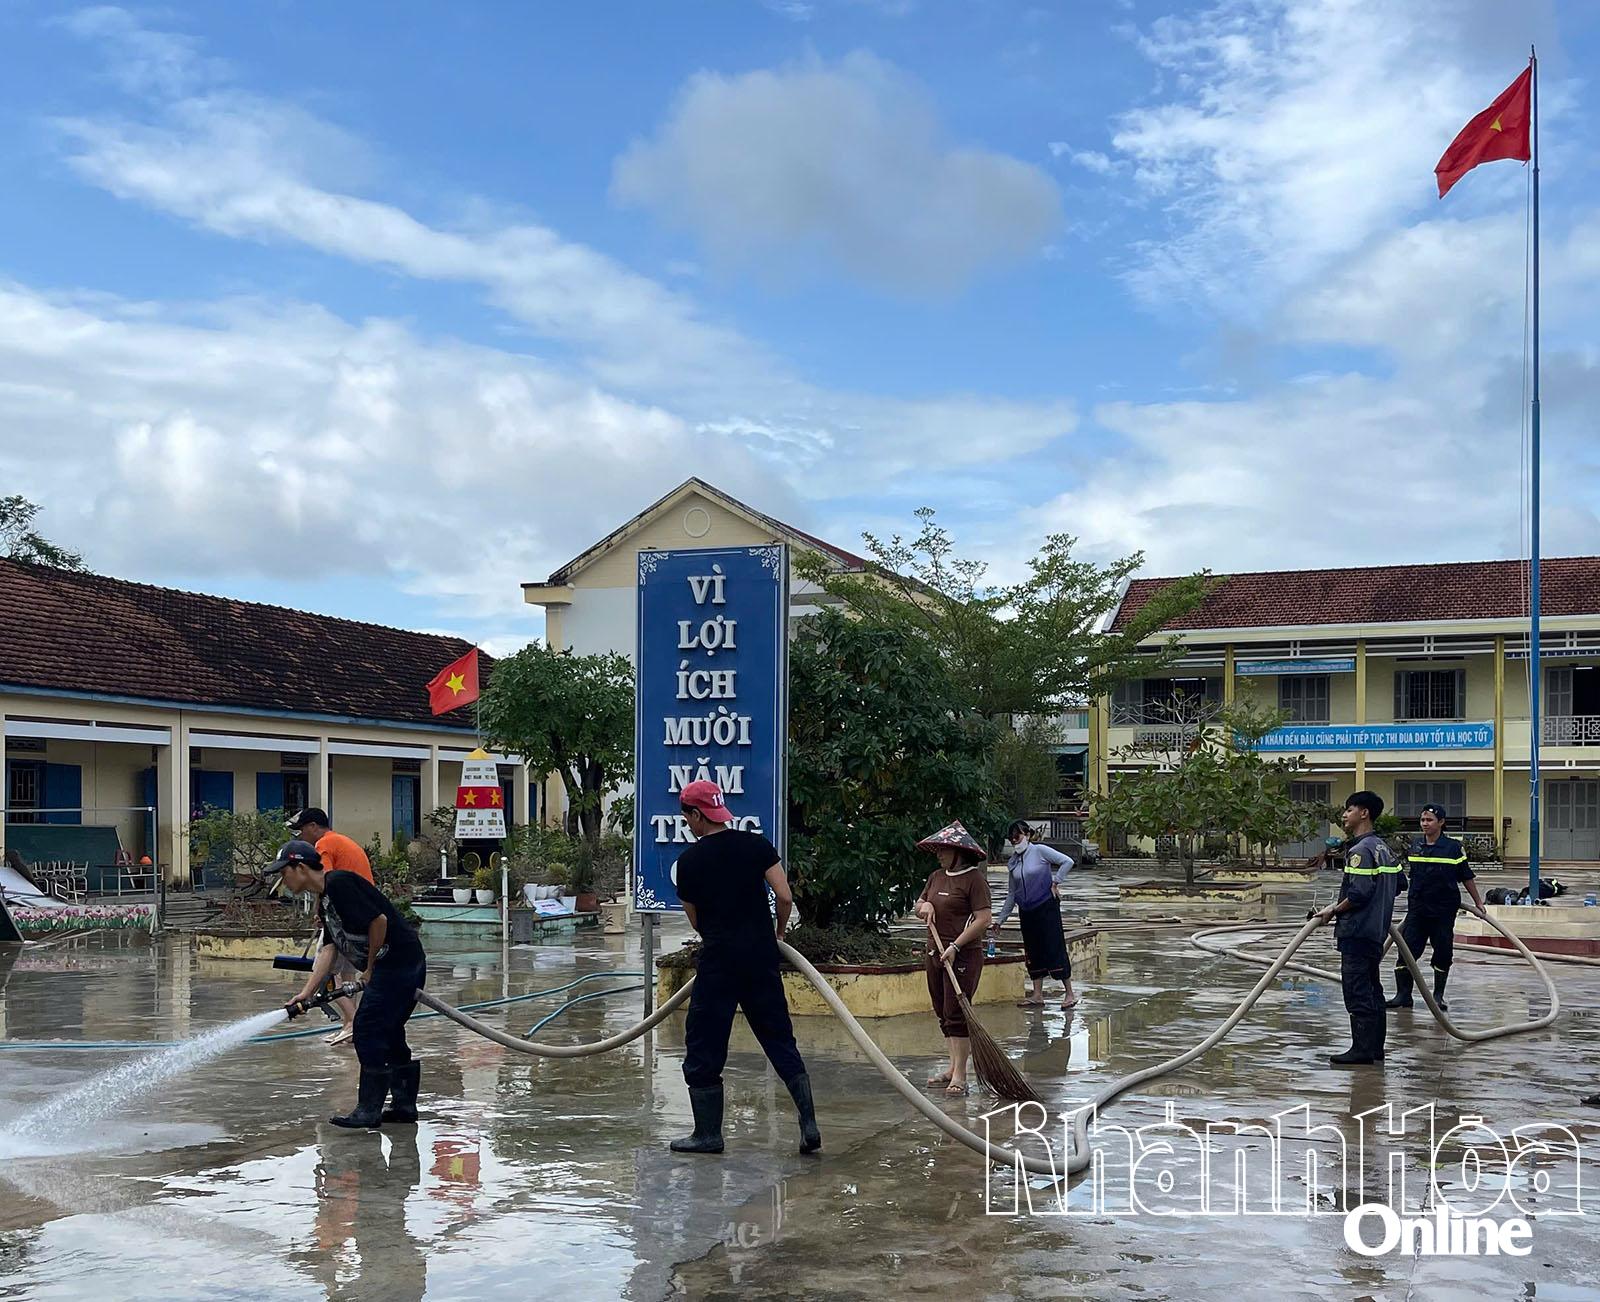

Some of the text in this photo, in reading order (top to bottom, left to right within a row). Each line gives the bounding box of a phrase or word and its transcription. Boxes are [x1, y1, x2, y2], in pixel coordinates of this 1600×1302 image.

[687, 564, 726, 604] VÌ
[677, 615, 737, 656] LỢI
[676, 660, 737, 699] ÍCH
[663, 705, 752, 745] MƯỜI
[1353, 729, 1369, 744] TIẾP
[1370, 733, 1385, 746] TỤC
[1385, 732, 1398, 744] THI
[1429, 727, 1444, 743] TỐT
[1446, 728, 1456, 743] VÀ
[1457, 731, 1472, 744] HỌC
[1473, 726, 1488, 741] TỐT
